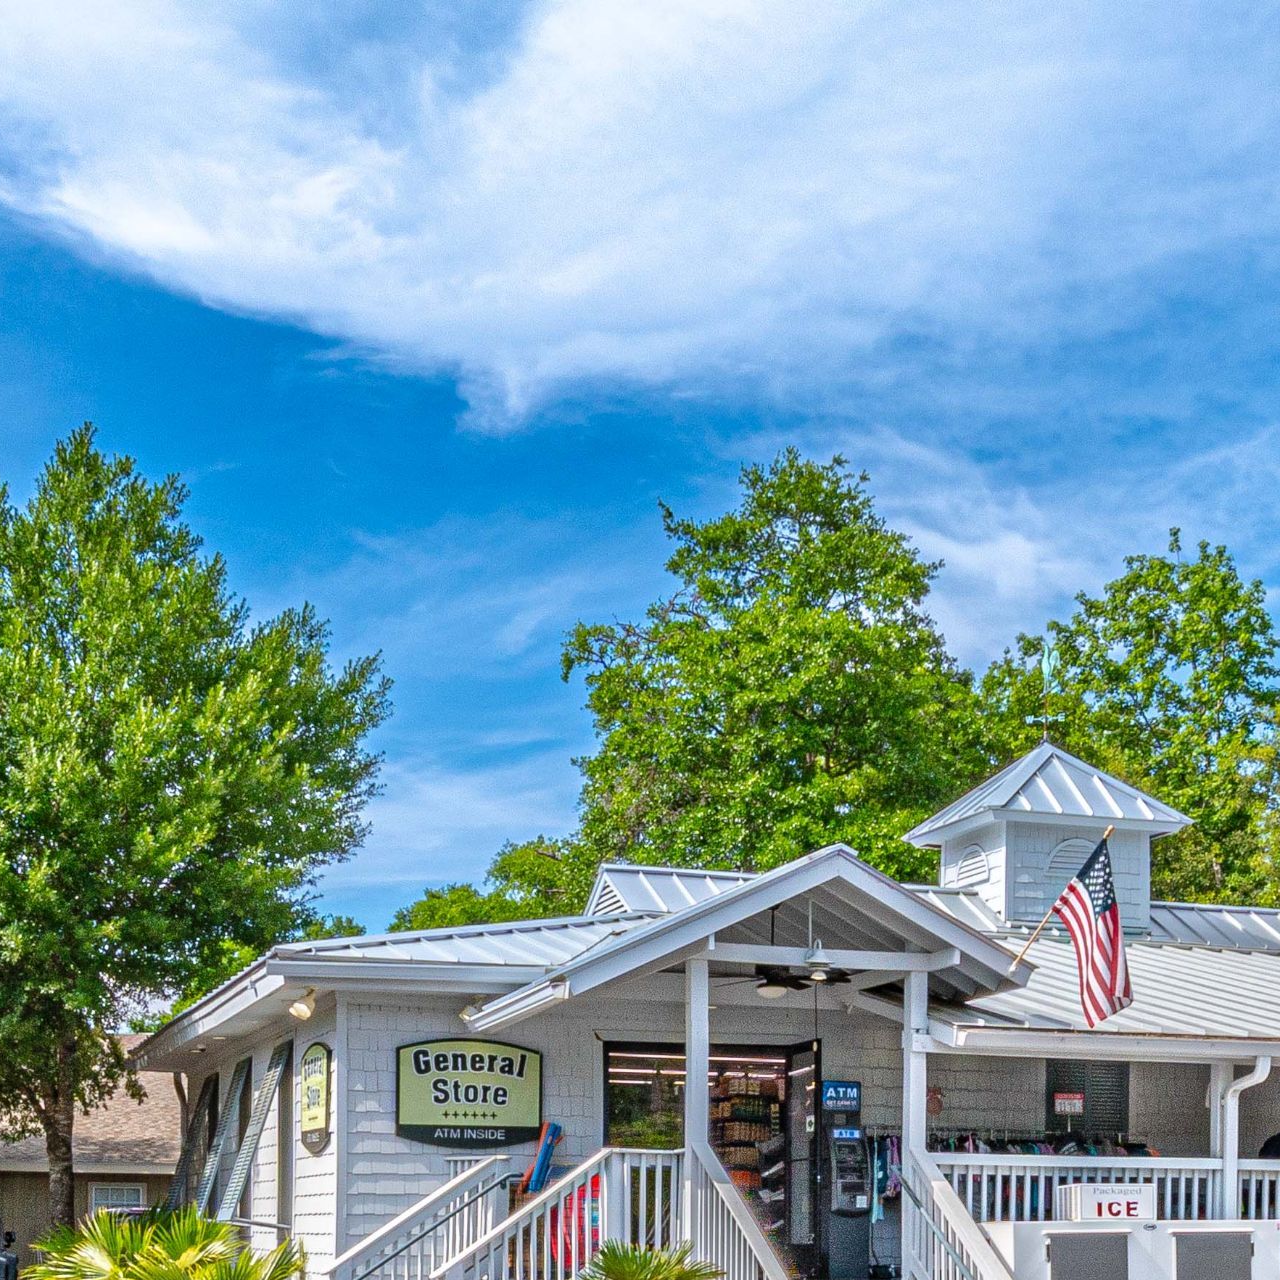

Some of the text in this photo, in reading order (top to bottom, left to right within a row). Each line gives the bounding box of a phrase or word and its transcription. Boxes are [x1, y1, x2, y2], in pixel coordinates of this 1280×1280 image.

[412, 1048, 528, 1079] General
[431, 1078, 509, 1106] Store
[826, 1087, 858, 1098] ATM
[434, 1128, 506, 1140] ATM INSIDE
[1093, 1187, 1142, 1196] Packaged
[1096, 1201, 1139, 1217] ICE
